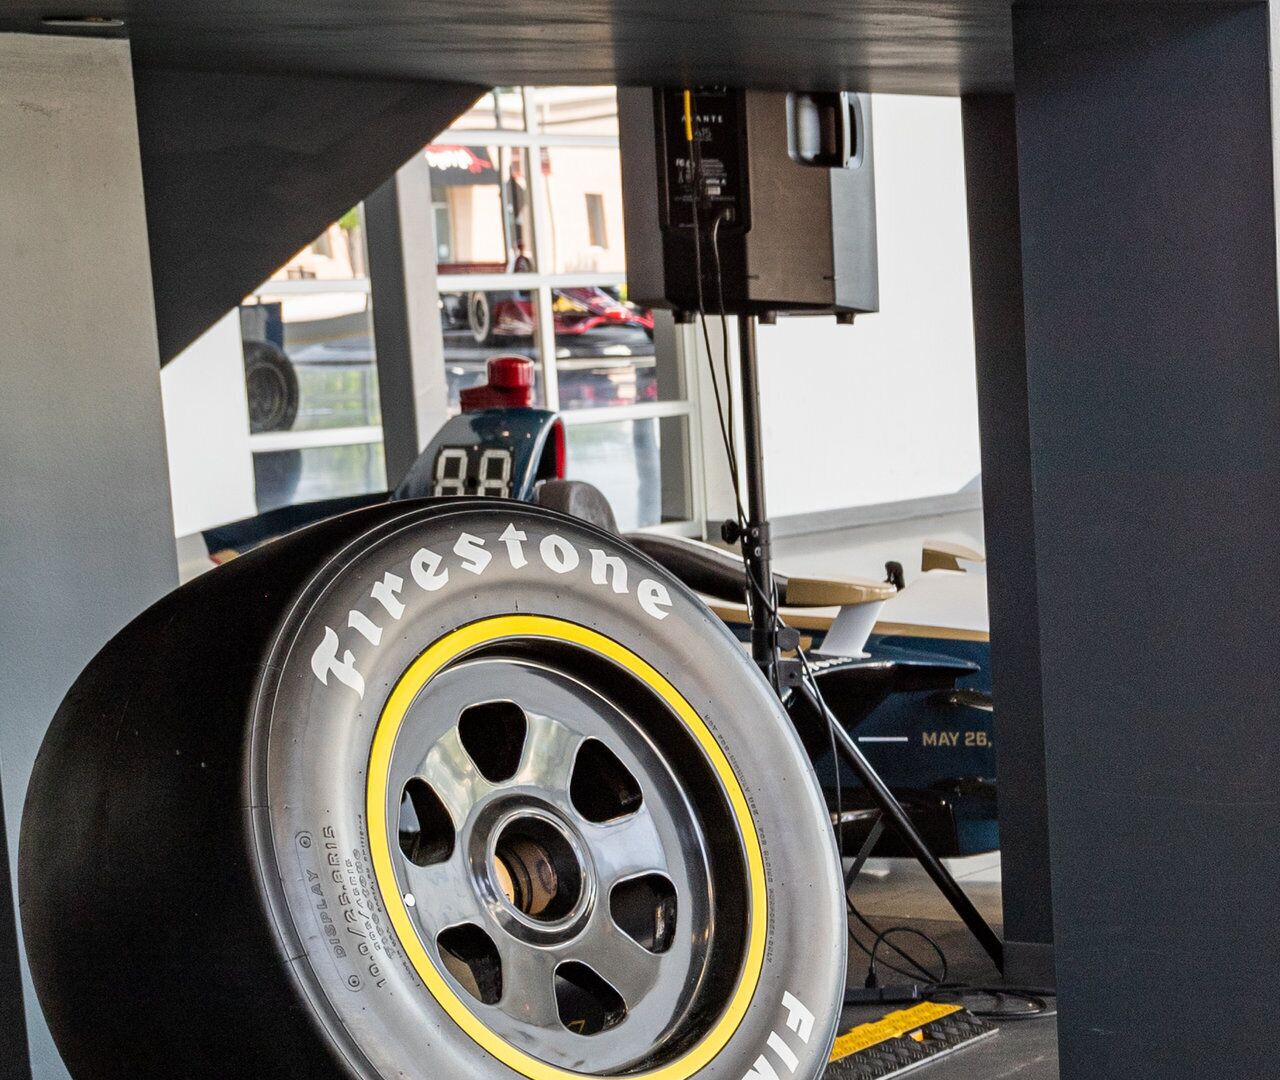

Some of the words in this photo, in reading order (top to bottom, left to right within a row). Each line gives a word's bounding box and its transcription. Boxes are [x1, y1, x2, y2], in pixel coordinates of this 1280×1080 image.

[311, 523, 673, 699] Firestone
[922, 731, 960, 746] MAY
[306, 868, 347, 959] DISPLAY
